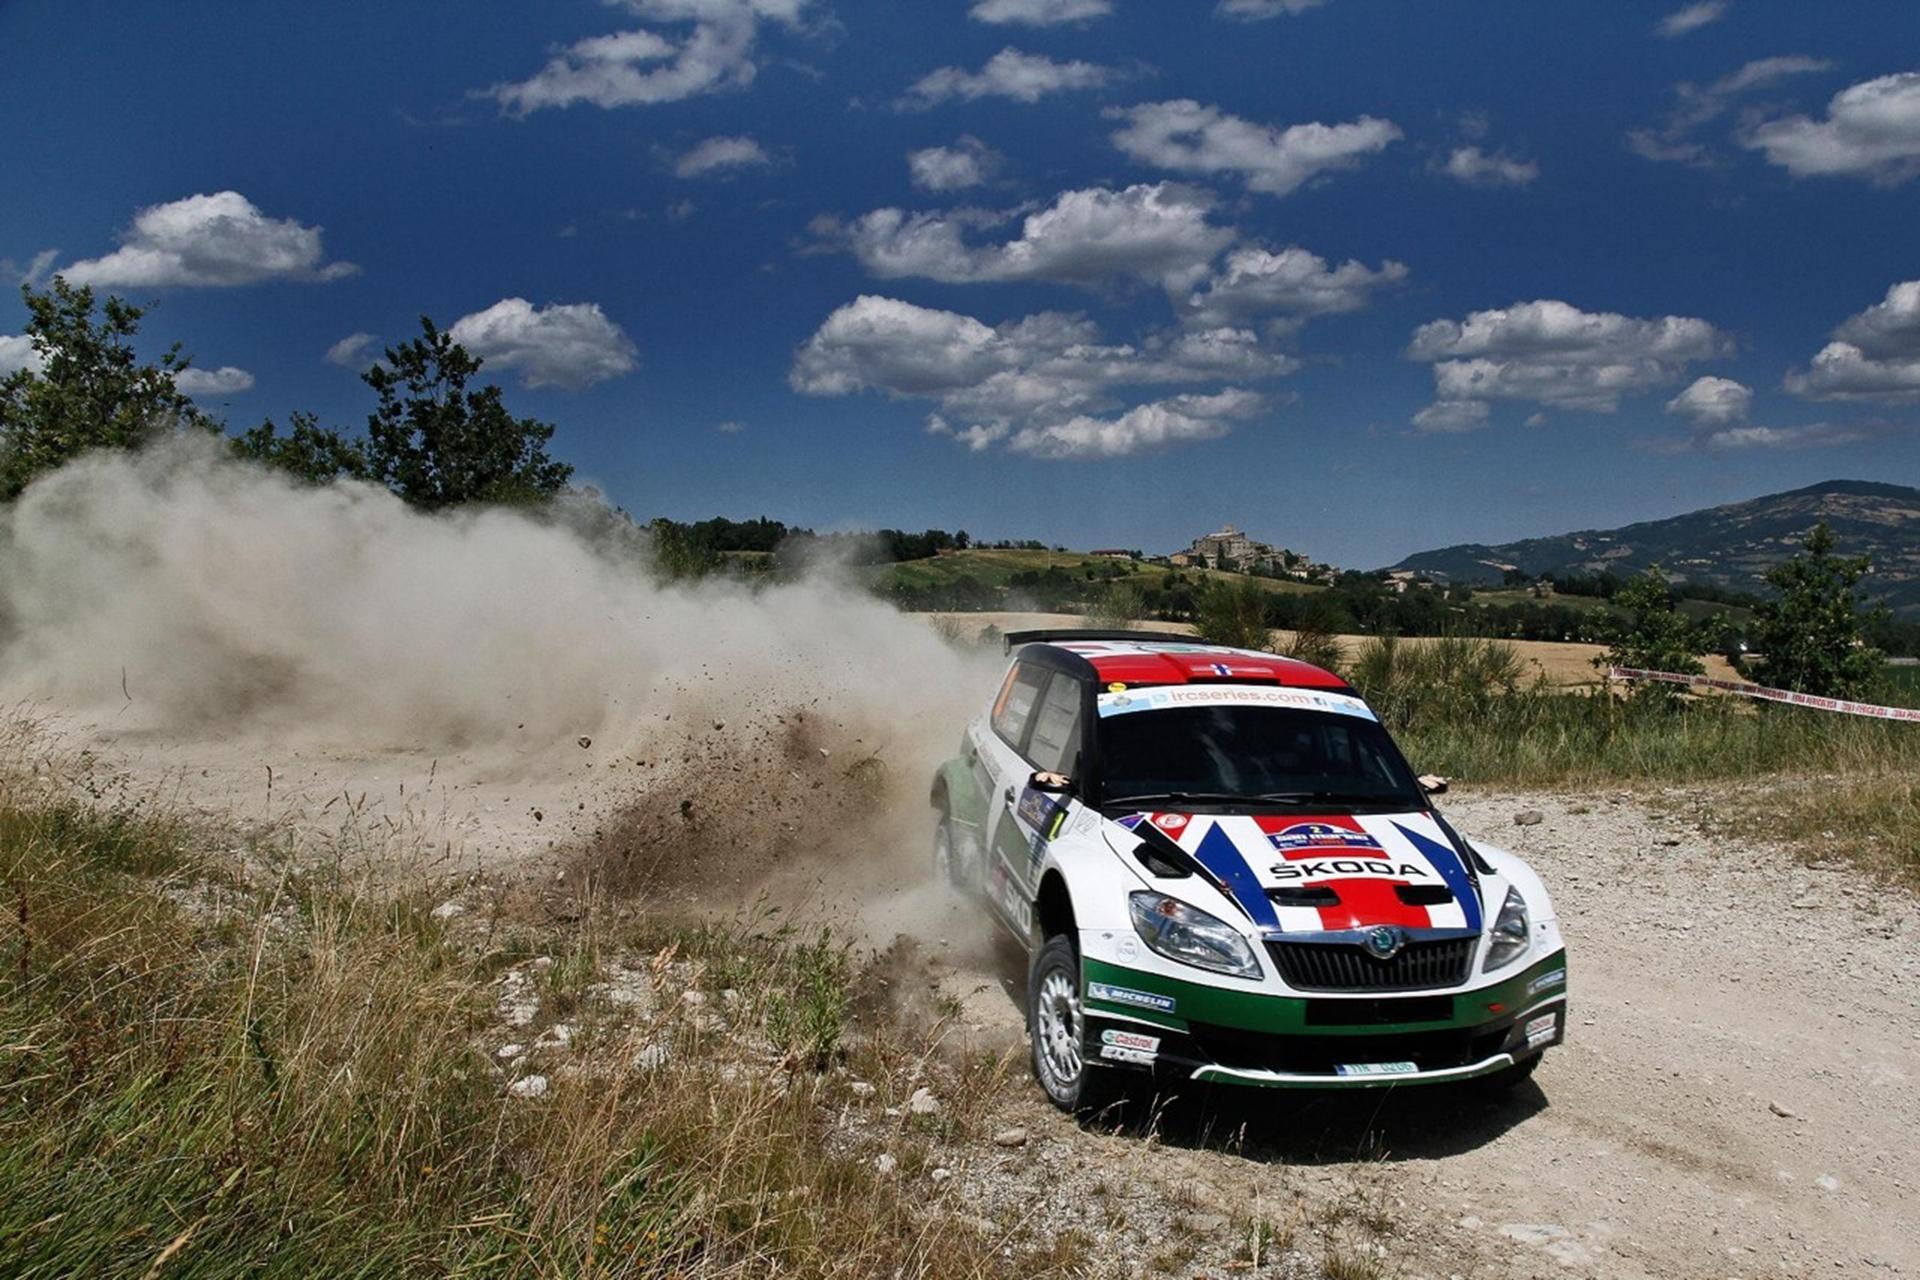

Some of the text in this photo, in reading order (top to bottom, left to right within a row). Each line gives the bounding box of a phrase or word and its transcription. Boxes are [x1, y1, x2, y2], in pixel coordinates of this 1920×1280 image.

[1309, 826, 1322, 834] 2
[1270, 861, 1428, 879] ŠKODA
[1110, 988, 1172, 1008] MICHELIN
[1115, 1034, 1153, 1049] Castrol
